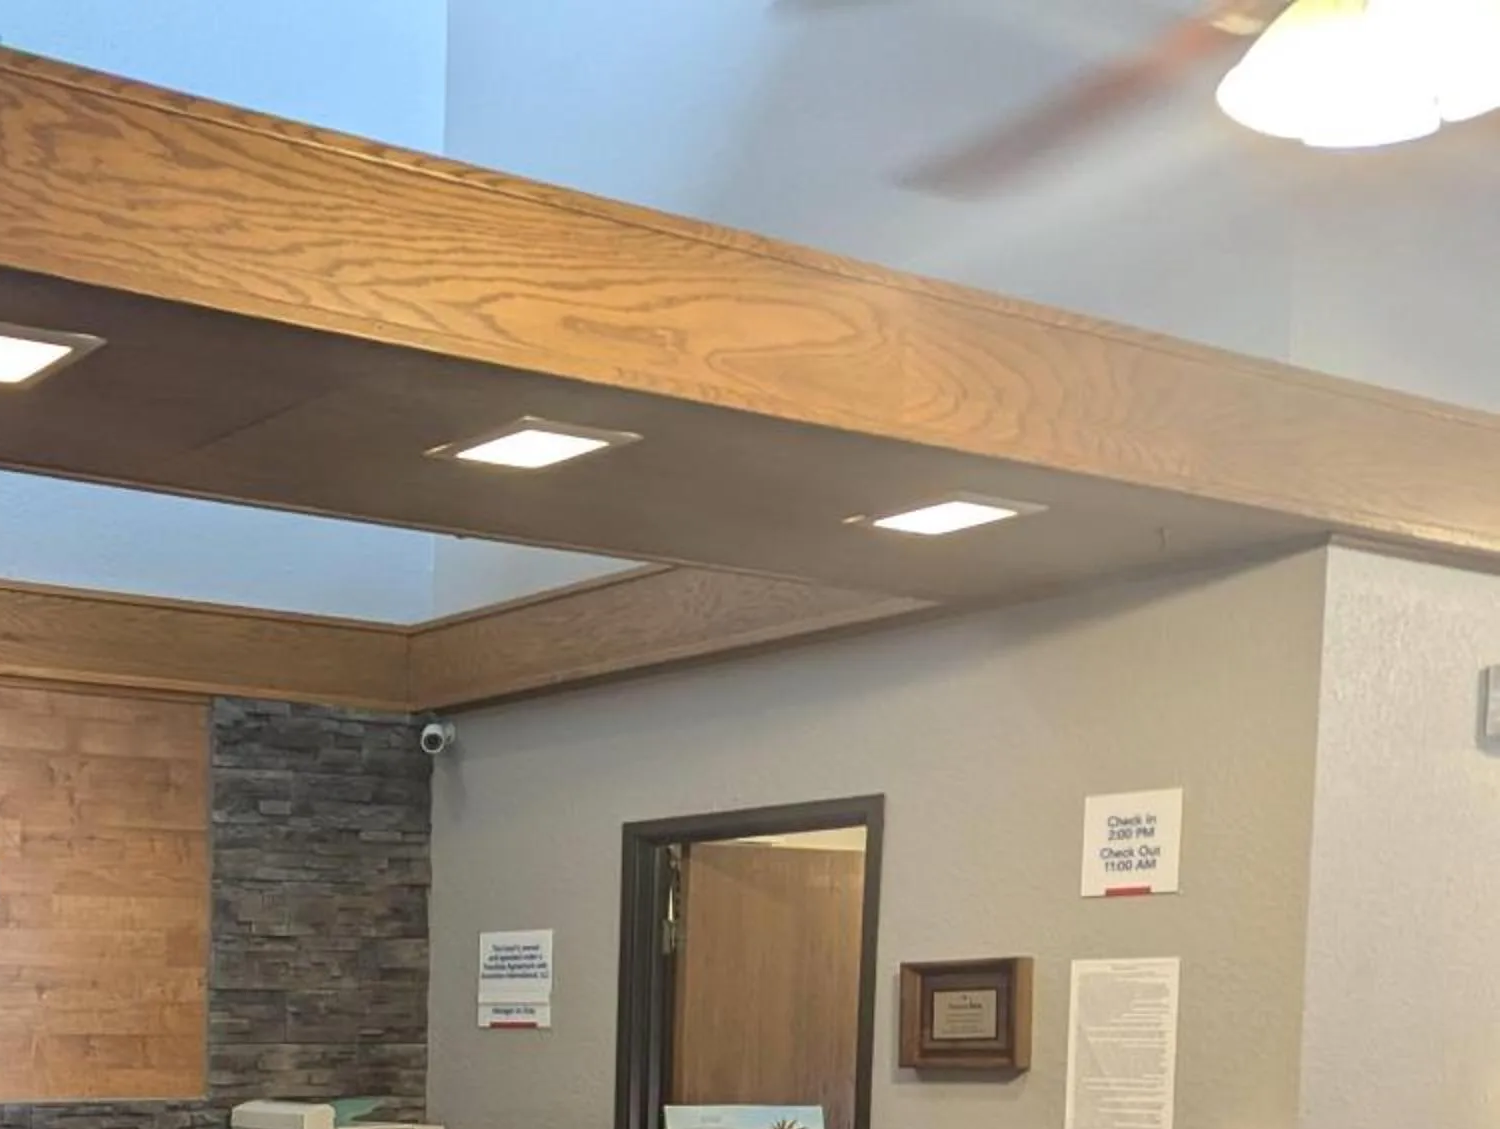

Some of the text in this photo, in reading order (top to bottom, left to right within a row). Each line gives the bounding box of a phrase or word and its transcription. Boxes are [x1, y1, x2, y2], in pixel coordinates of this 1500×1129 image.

[1107, 814, 1142, 827] Check
[1135, 826, 1155, 839] PM
[1100, 844, 1161, 860] Check Out
[1135, 858, 1157, 871] AM
